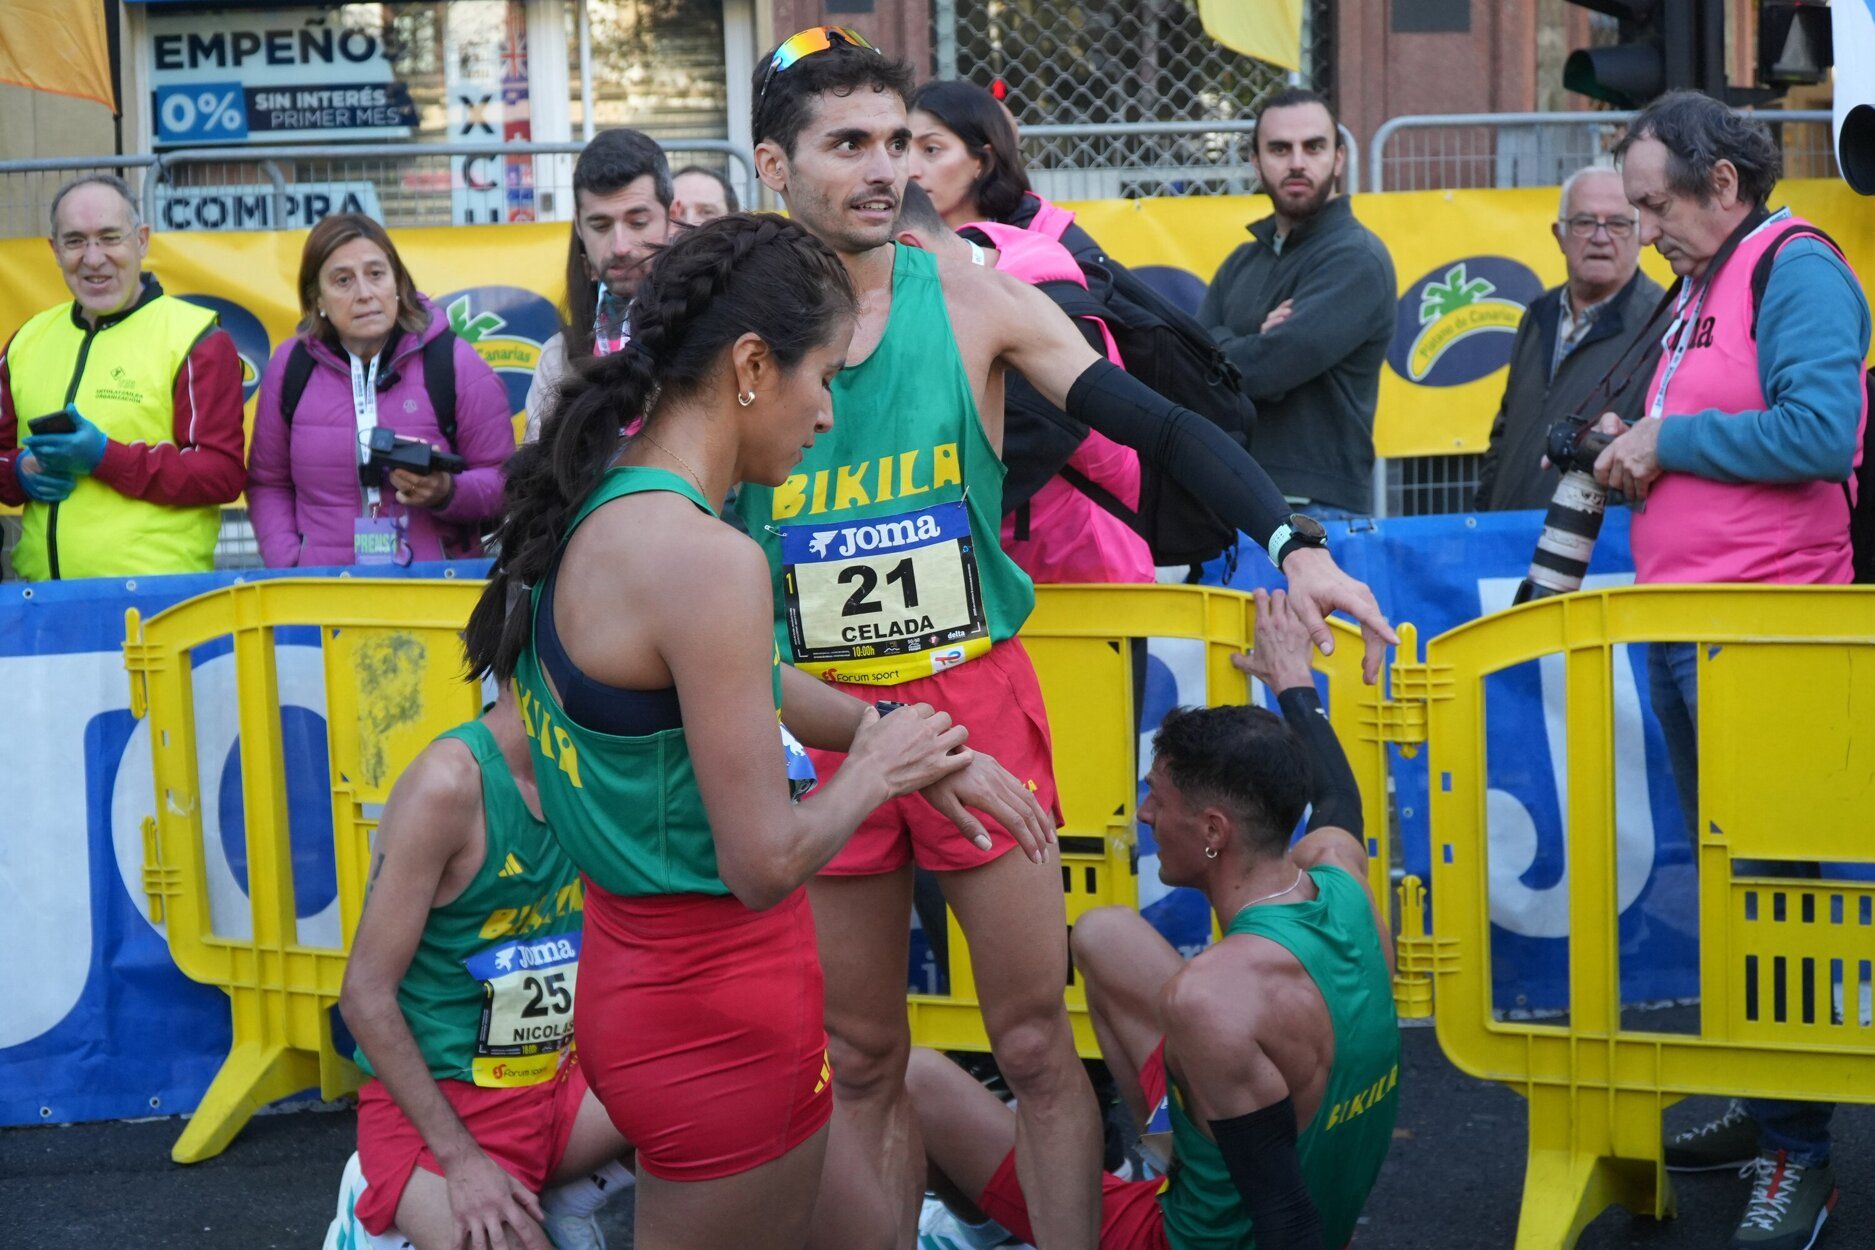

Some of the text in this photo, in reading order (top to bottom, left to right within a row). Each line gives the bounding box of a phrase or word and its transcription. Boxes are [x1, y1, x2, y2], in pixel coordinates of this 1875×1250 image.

[255, 86, 387, 111] SIN INTERÉS
[161, 91, 241, 133] 0%
[271, 106, 401, 128] PRIMER MES
[477, 345, 532, 364] anarias
[772, 442, 962, 521] BIKILA
[785, 572, 794, 595] 1
[837, 556, 920, 618] 21
[841, 615, 935, 643] CELADA
[947, 630, 966, 640] delta
[871, 670, 900, 682] sport
[520, 972, 572, 1019] 25
